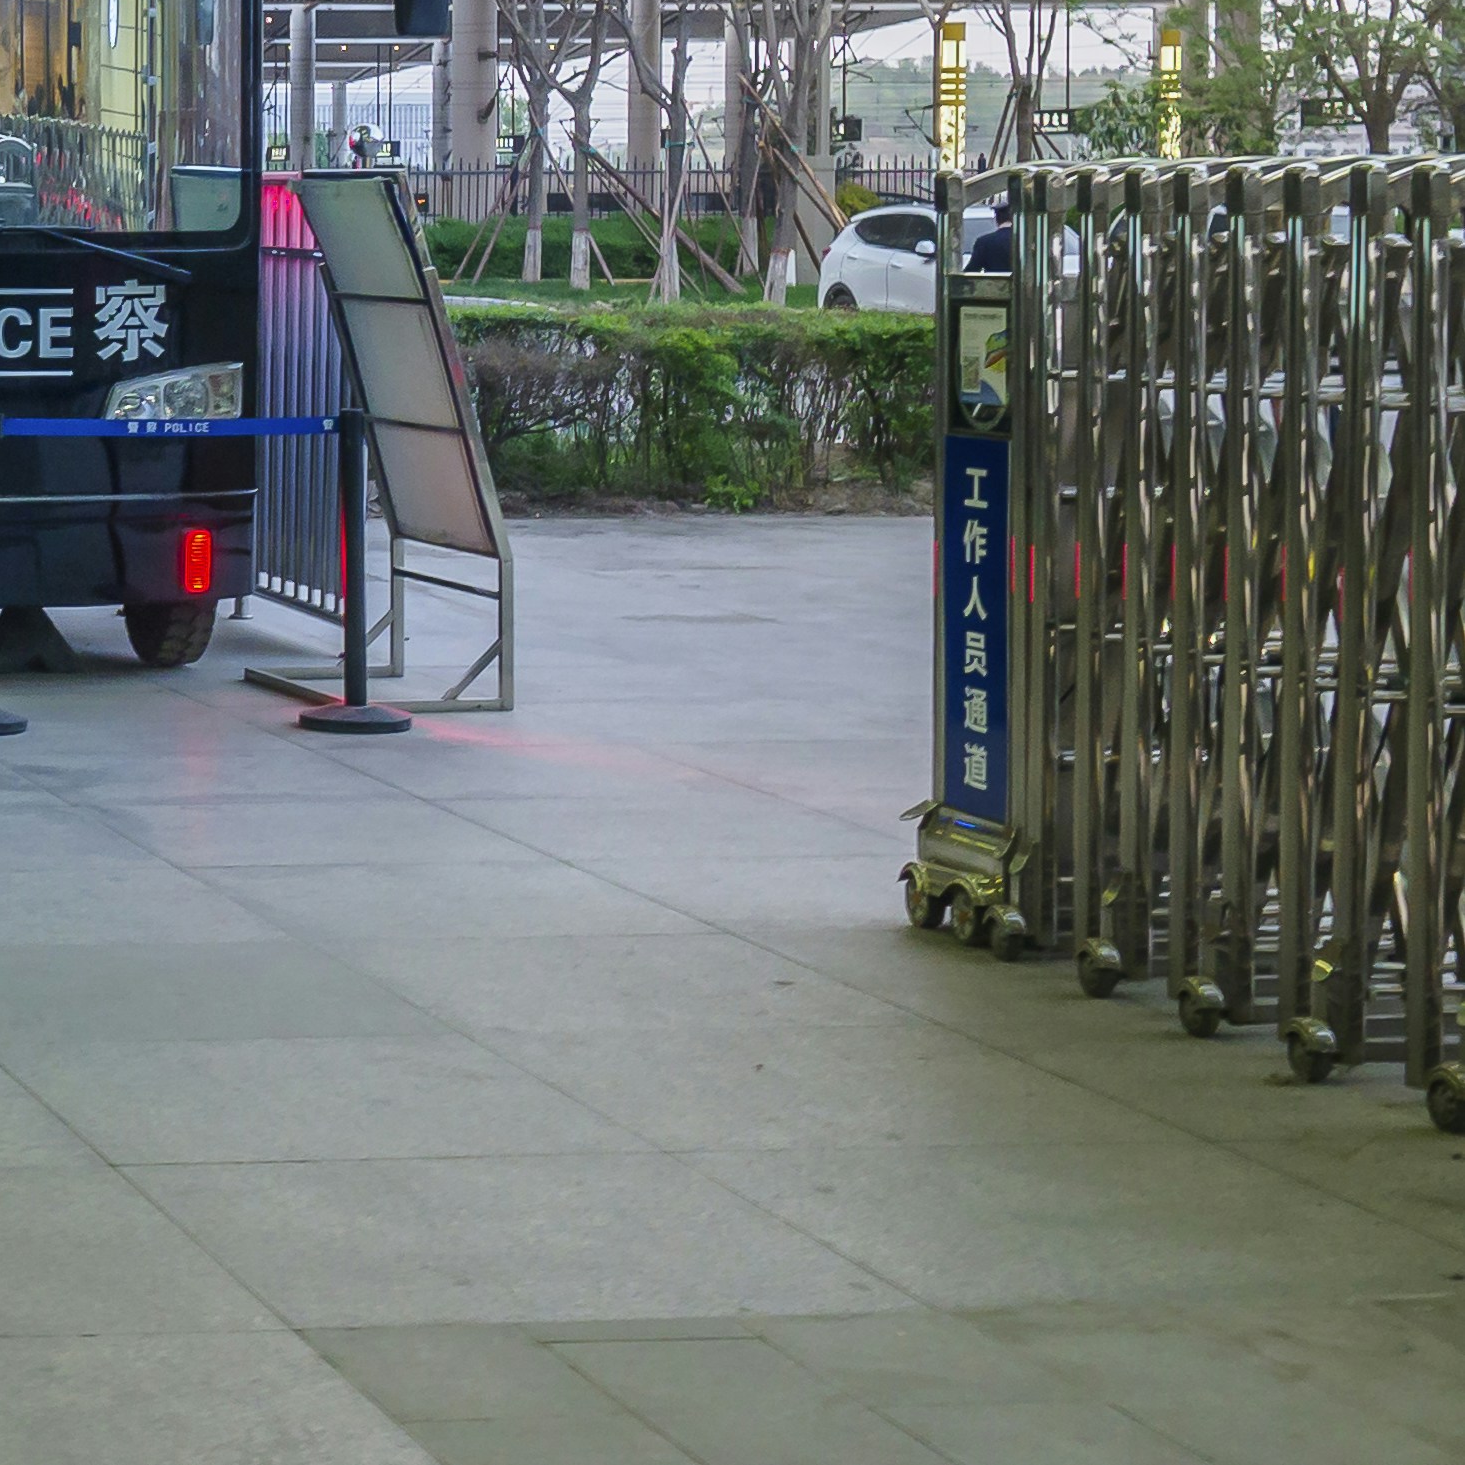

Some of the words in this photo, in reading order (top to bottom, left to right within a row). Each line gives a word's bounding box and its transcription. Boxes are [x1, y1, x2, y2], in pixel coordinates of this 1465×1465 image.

[93, 279, 169, 362] 察
[164, 421, 210, 433] POLICE
[963, 467, 988, 791] 工作人员通道
